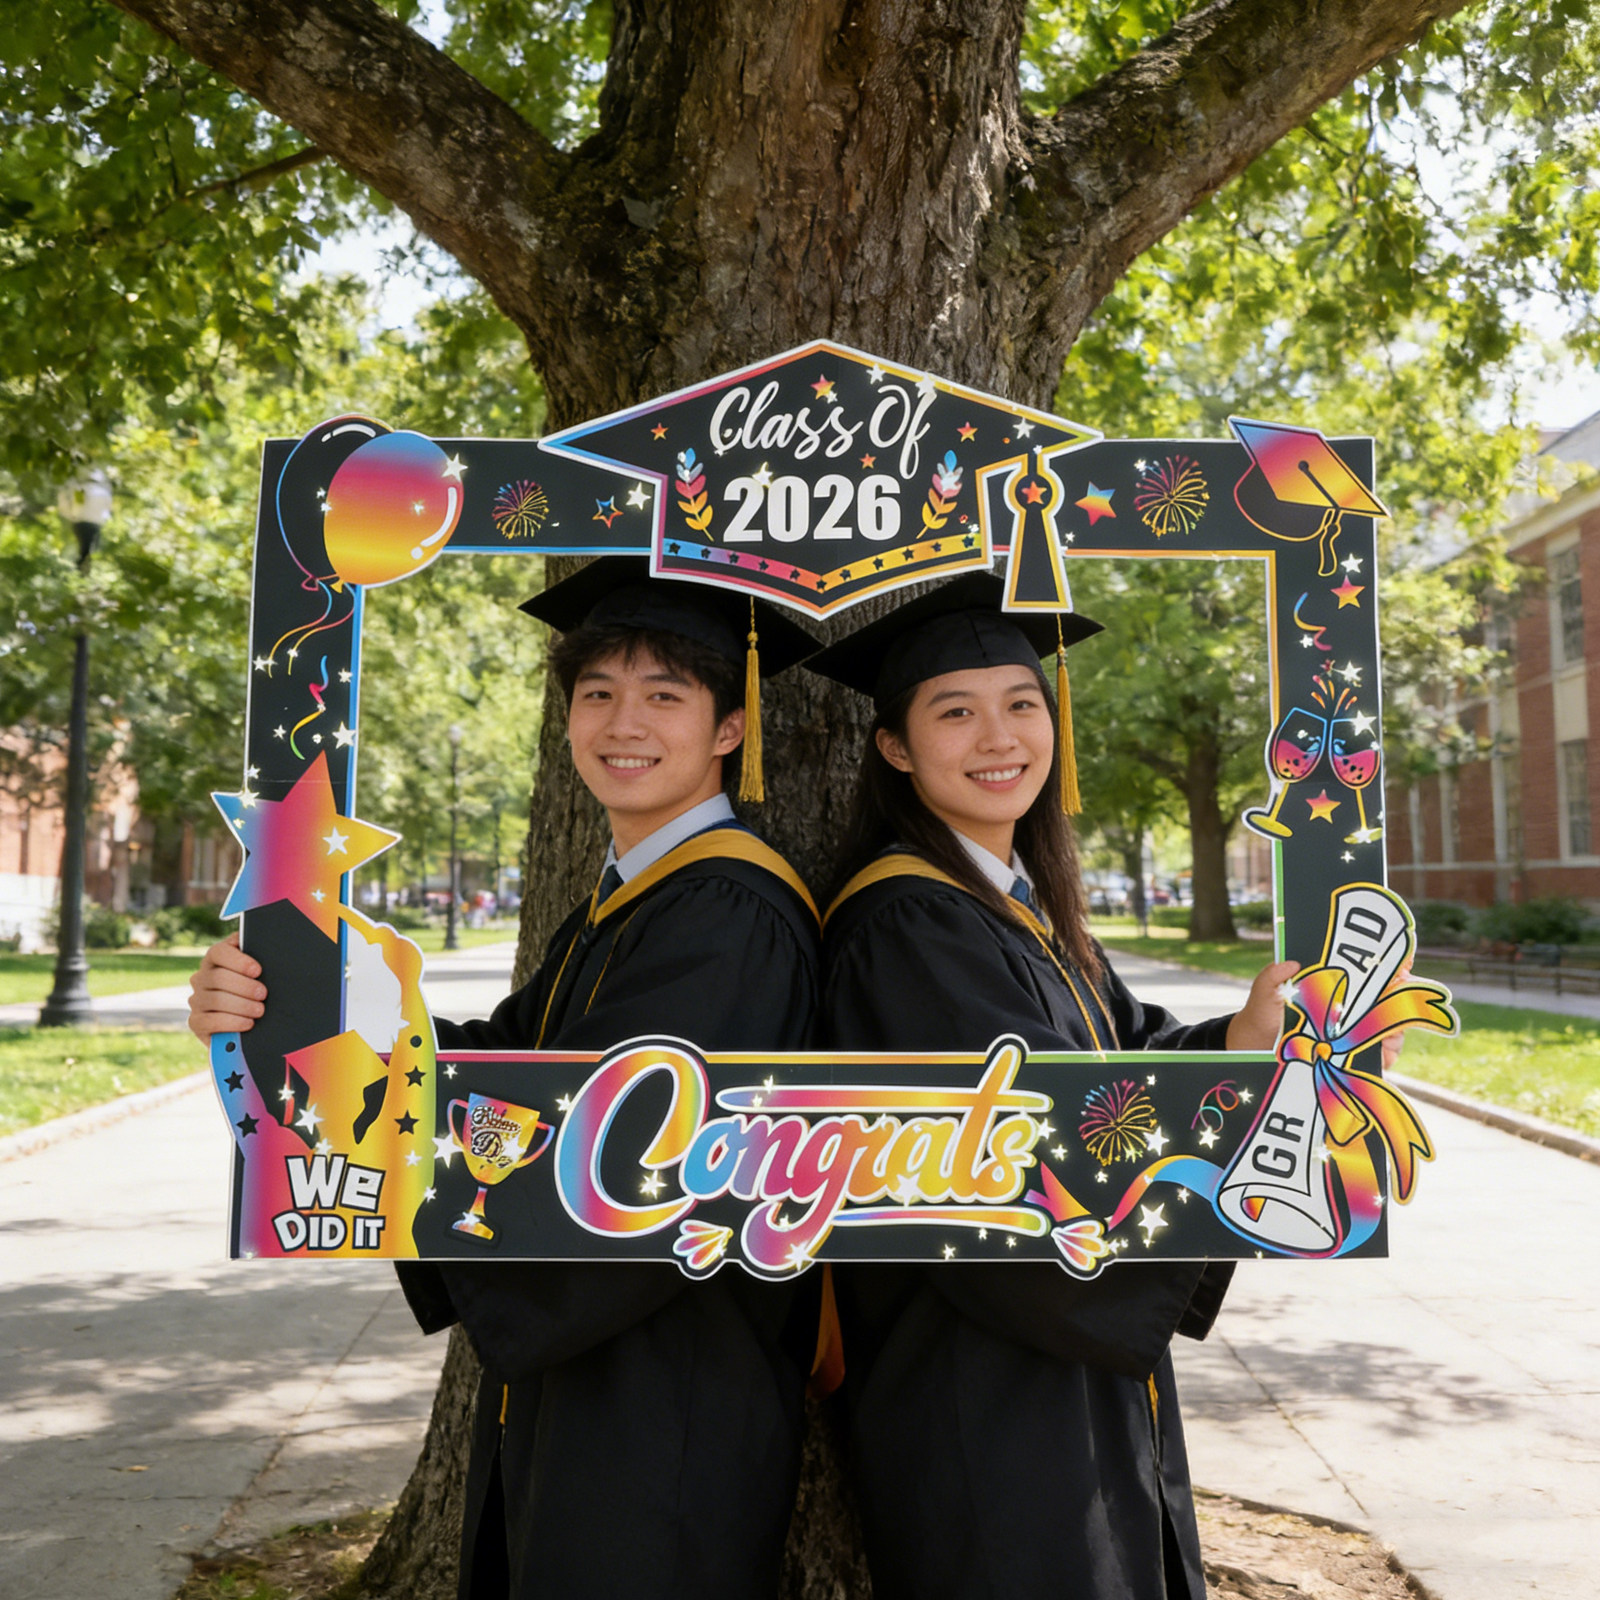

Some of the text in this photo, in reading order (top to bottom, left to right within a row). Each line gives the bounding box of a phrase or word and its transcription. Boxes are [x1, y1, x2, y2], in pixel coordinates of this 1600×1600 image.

[709, 381, 937, 480] Class Of
[723, 473, 901, 543] 2026
[554, 1043, 1054, 1271] Congrats
[272, 1209, 386, 1251] DID IT
